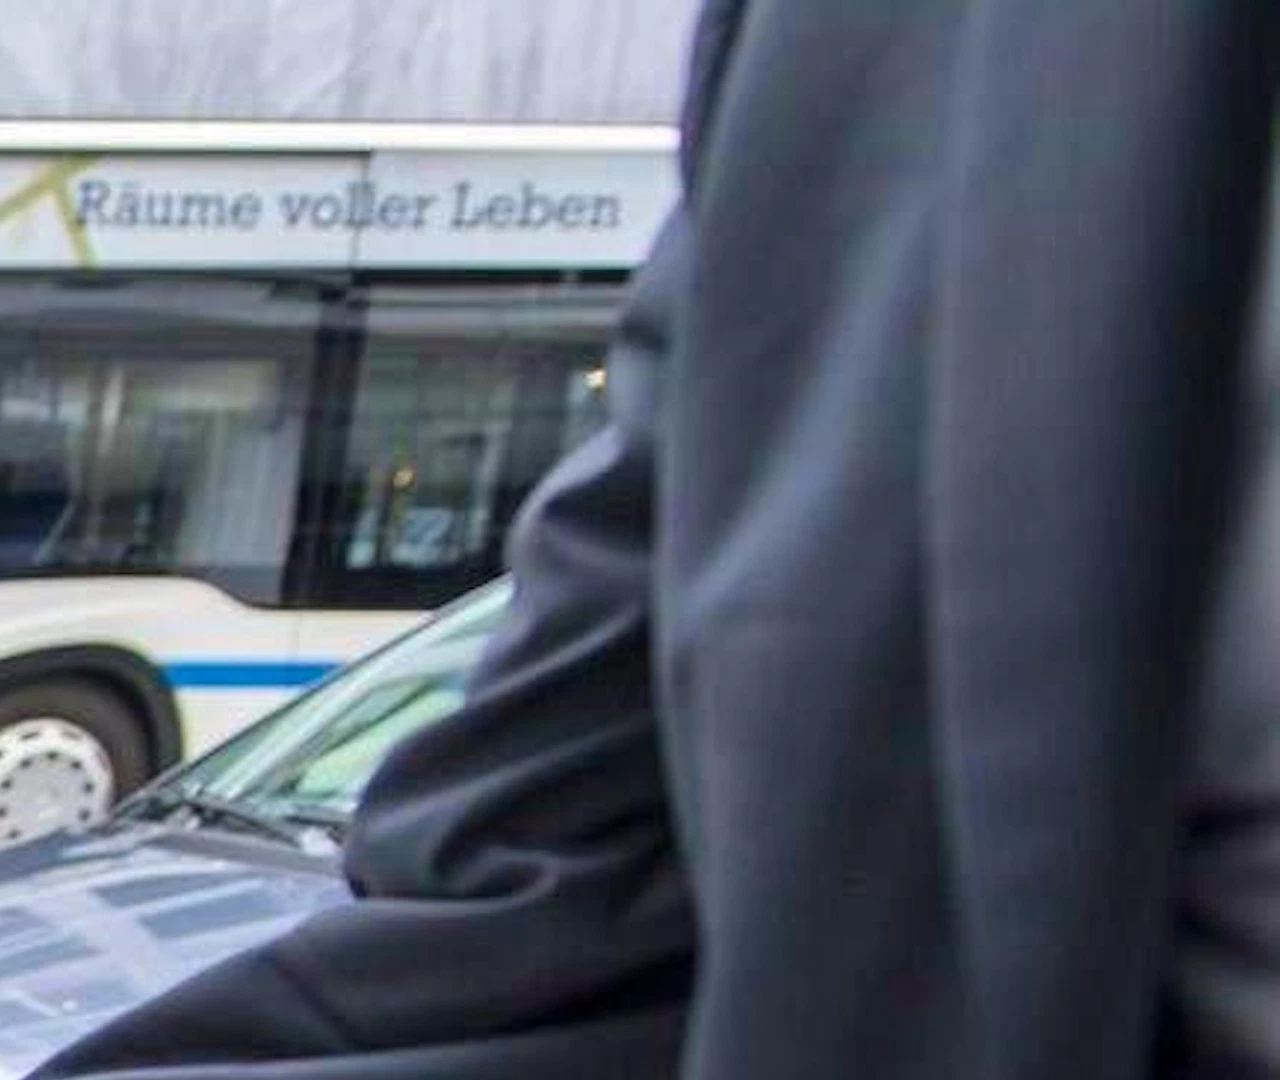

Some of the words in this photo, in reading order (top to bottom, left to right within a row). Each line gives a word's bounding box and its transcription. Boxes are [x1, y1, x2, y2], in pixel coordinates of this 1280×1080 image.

[74, 179, 263, 230] Räume
[278, 180, 440, 230] voller
[448, 181, 624, 231] Leben
